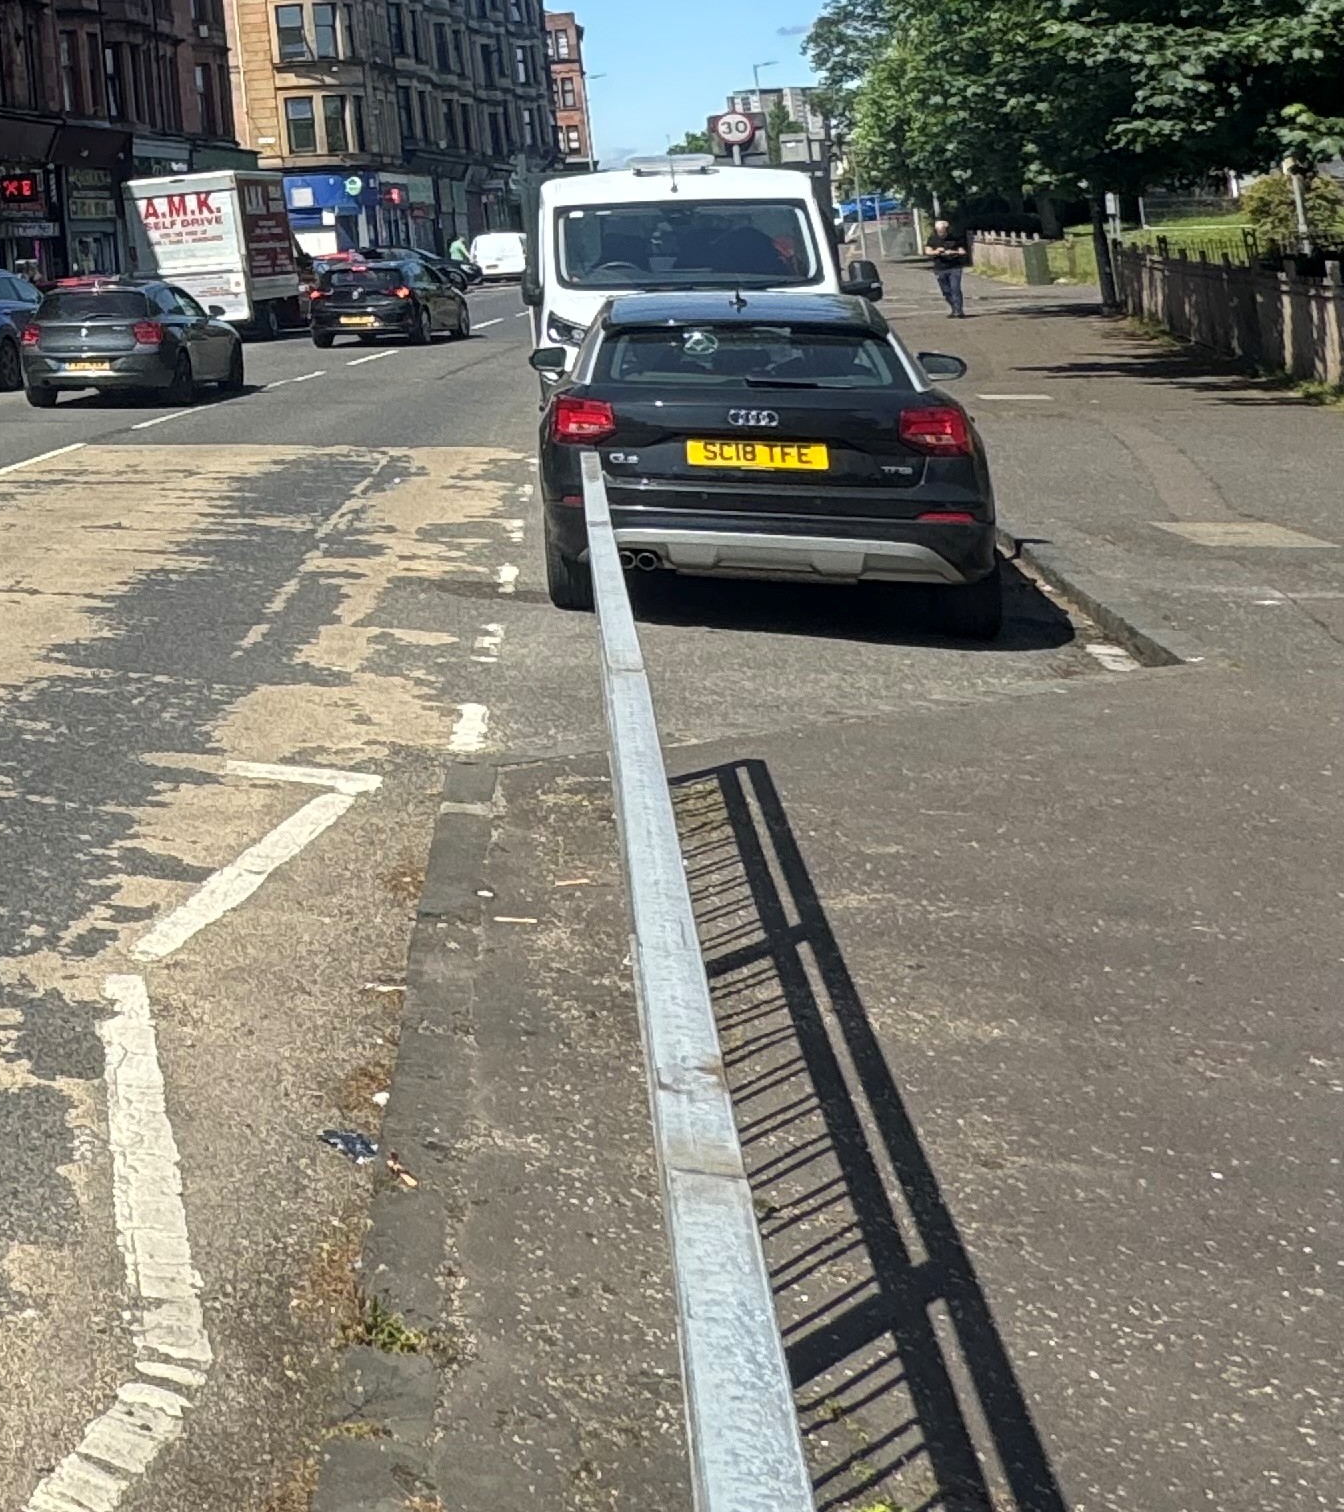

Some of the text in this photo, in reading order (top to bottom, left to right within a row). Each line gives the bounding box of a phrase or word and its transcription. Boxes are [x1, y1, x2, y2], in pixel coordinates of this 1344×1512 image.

[720, 120, 748, 135] 30
[144, 192, 222, 219] A.M.K.
[143, 215, 223, 230] SELF DRIVE
[703, 441, 813, 464] SC18 TFE
